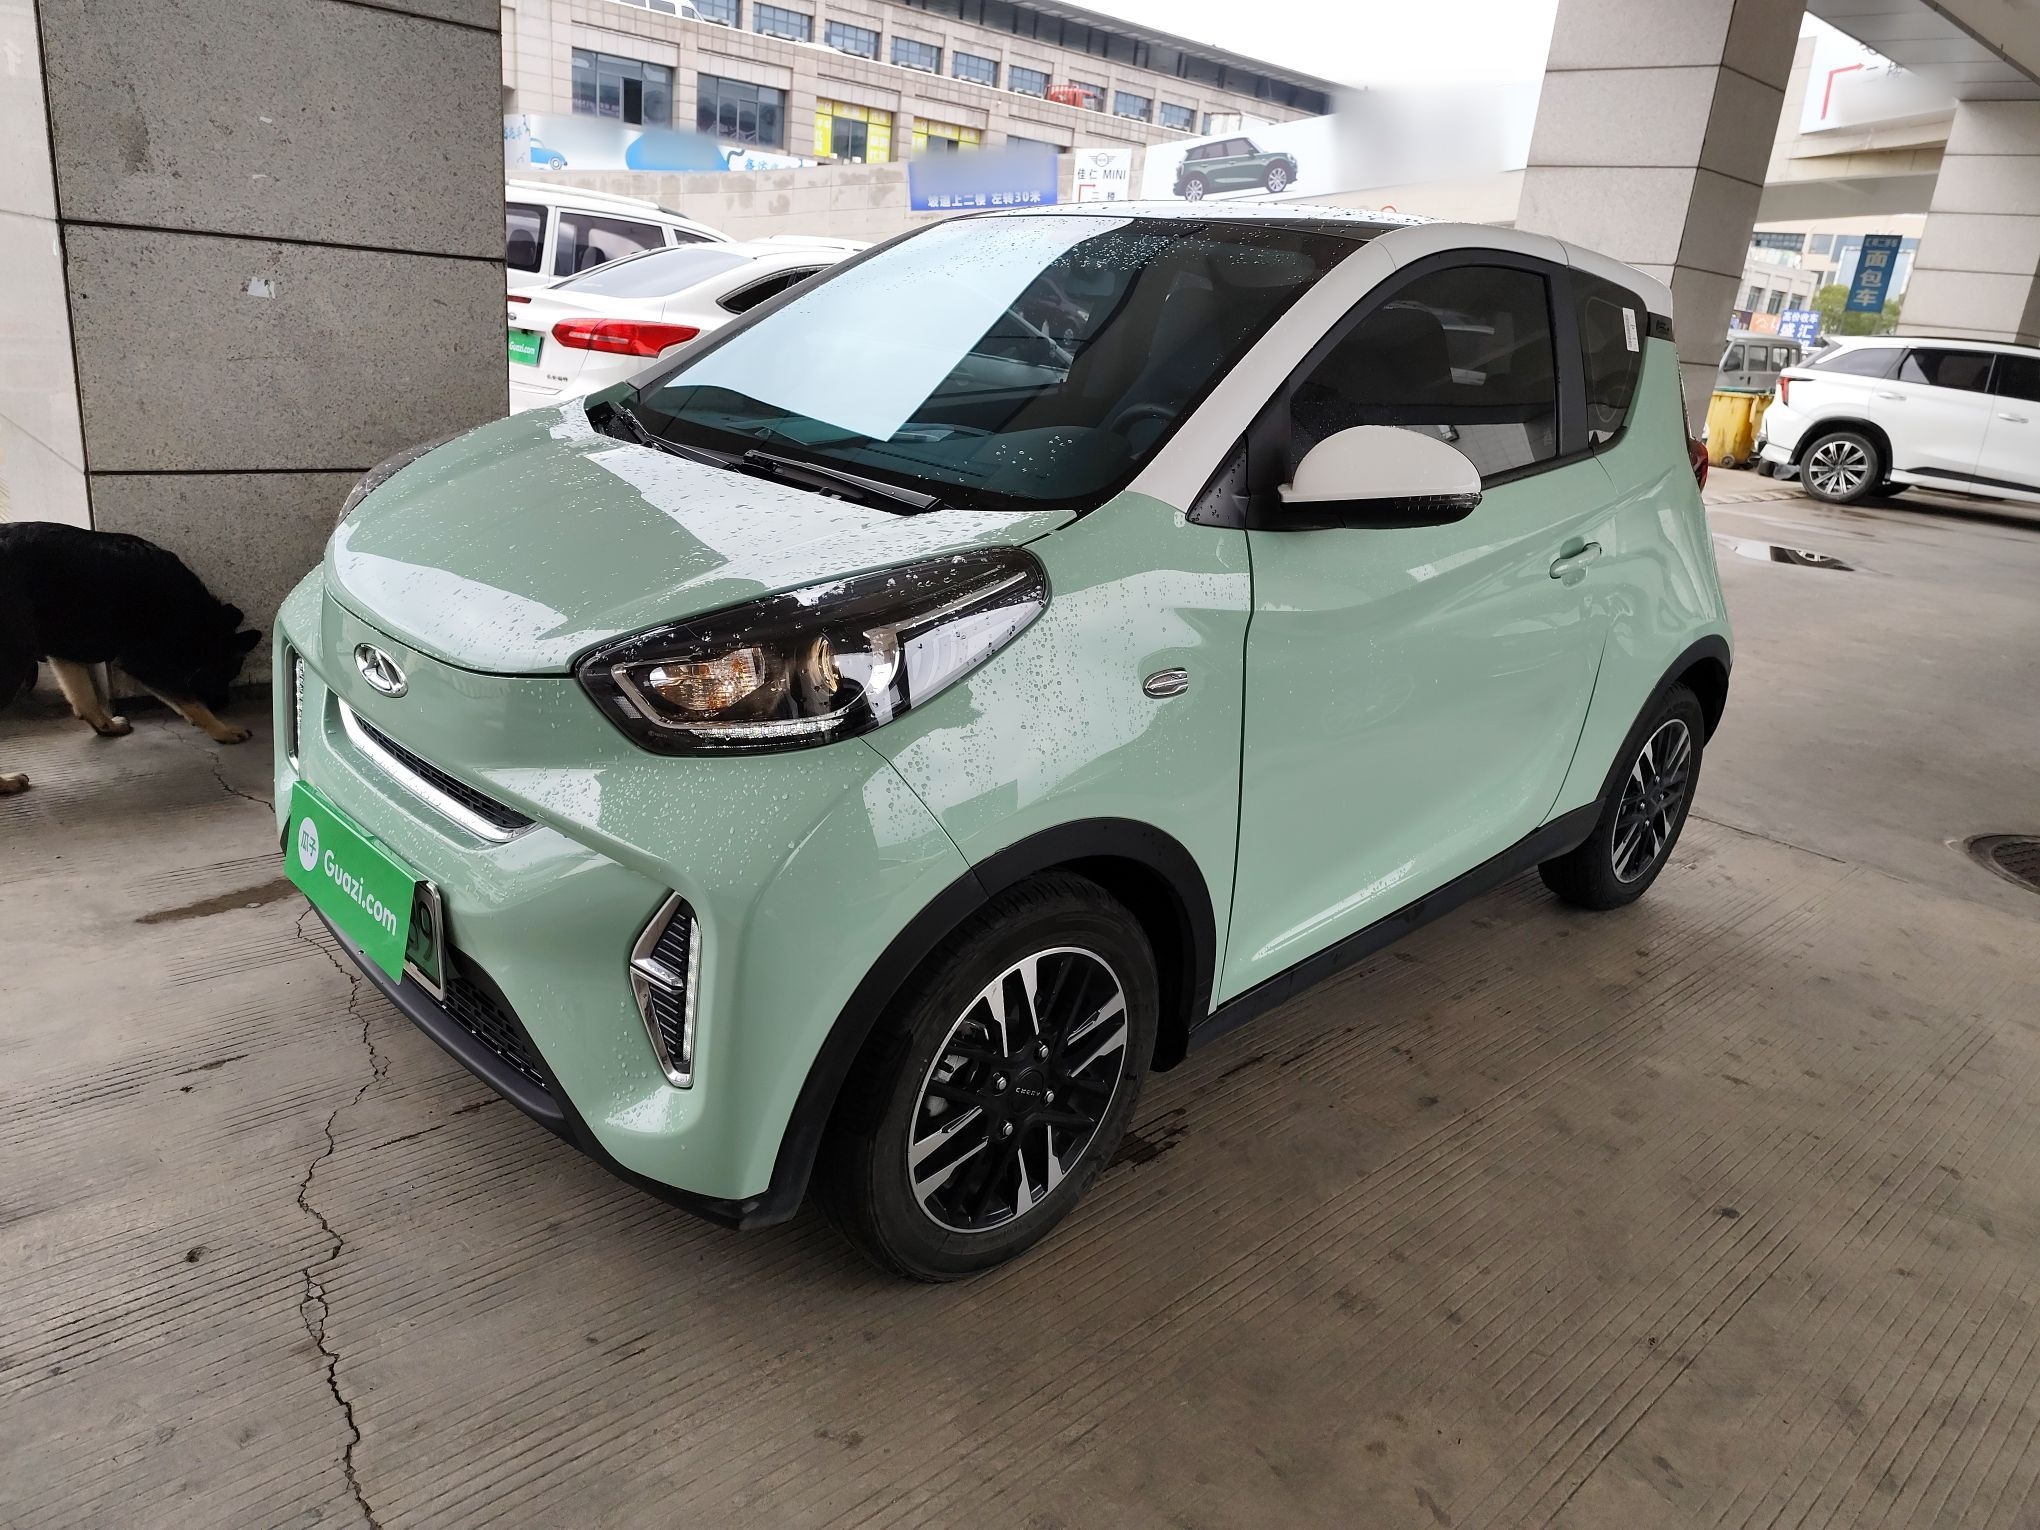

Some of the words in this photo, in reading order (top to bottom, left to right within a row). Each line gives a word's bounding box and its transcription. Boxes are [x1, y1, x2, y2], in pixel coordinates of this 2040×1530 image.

[1103, 169, 1127, 180] MINI
[991, 189, 1041, 205] 左转30米
[1853, 250, 1891, 307] 面包车
[301, 830, 317, 857] 瓜子
[323, 848, 398, 936] Guazi.com
[1015, 1087, 1041, 1096] CHERY
